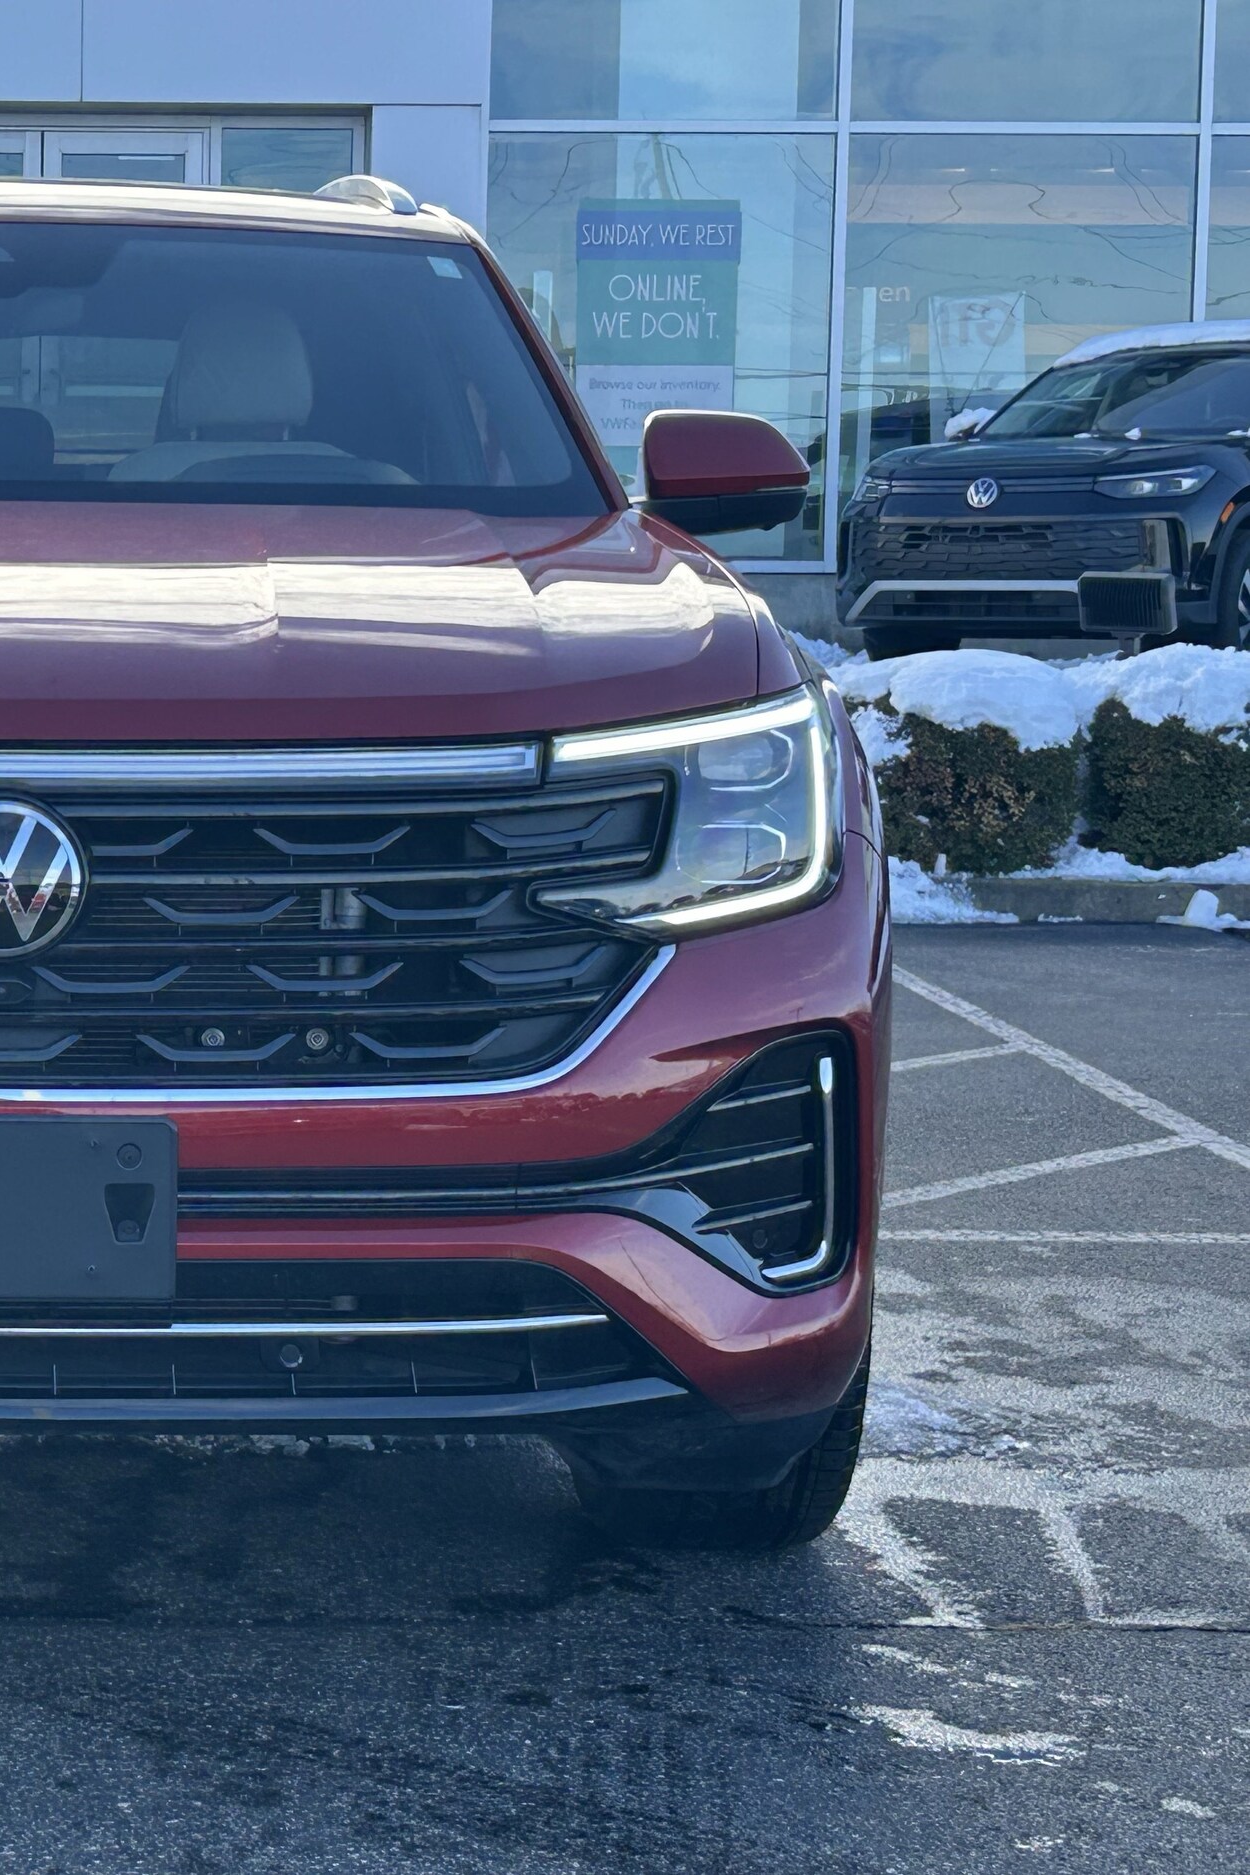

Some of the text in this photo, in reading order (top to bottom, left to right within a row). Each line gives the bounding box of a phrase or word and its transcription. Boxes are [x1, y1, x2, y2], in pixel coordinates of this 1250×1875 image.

[659, 223, 690, 246] WE
[695, 224, 735, 246] REST
[608, 273, 706, 304] ONLINE,
[592, 306, 719, 340] WE DON'T.
[588, 377, 633, 391] Browse
[636, 380, 658, 390] our
